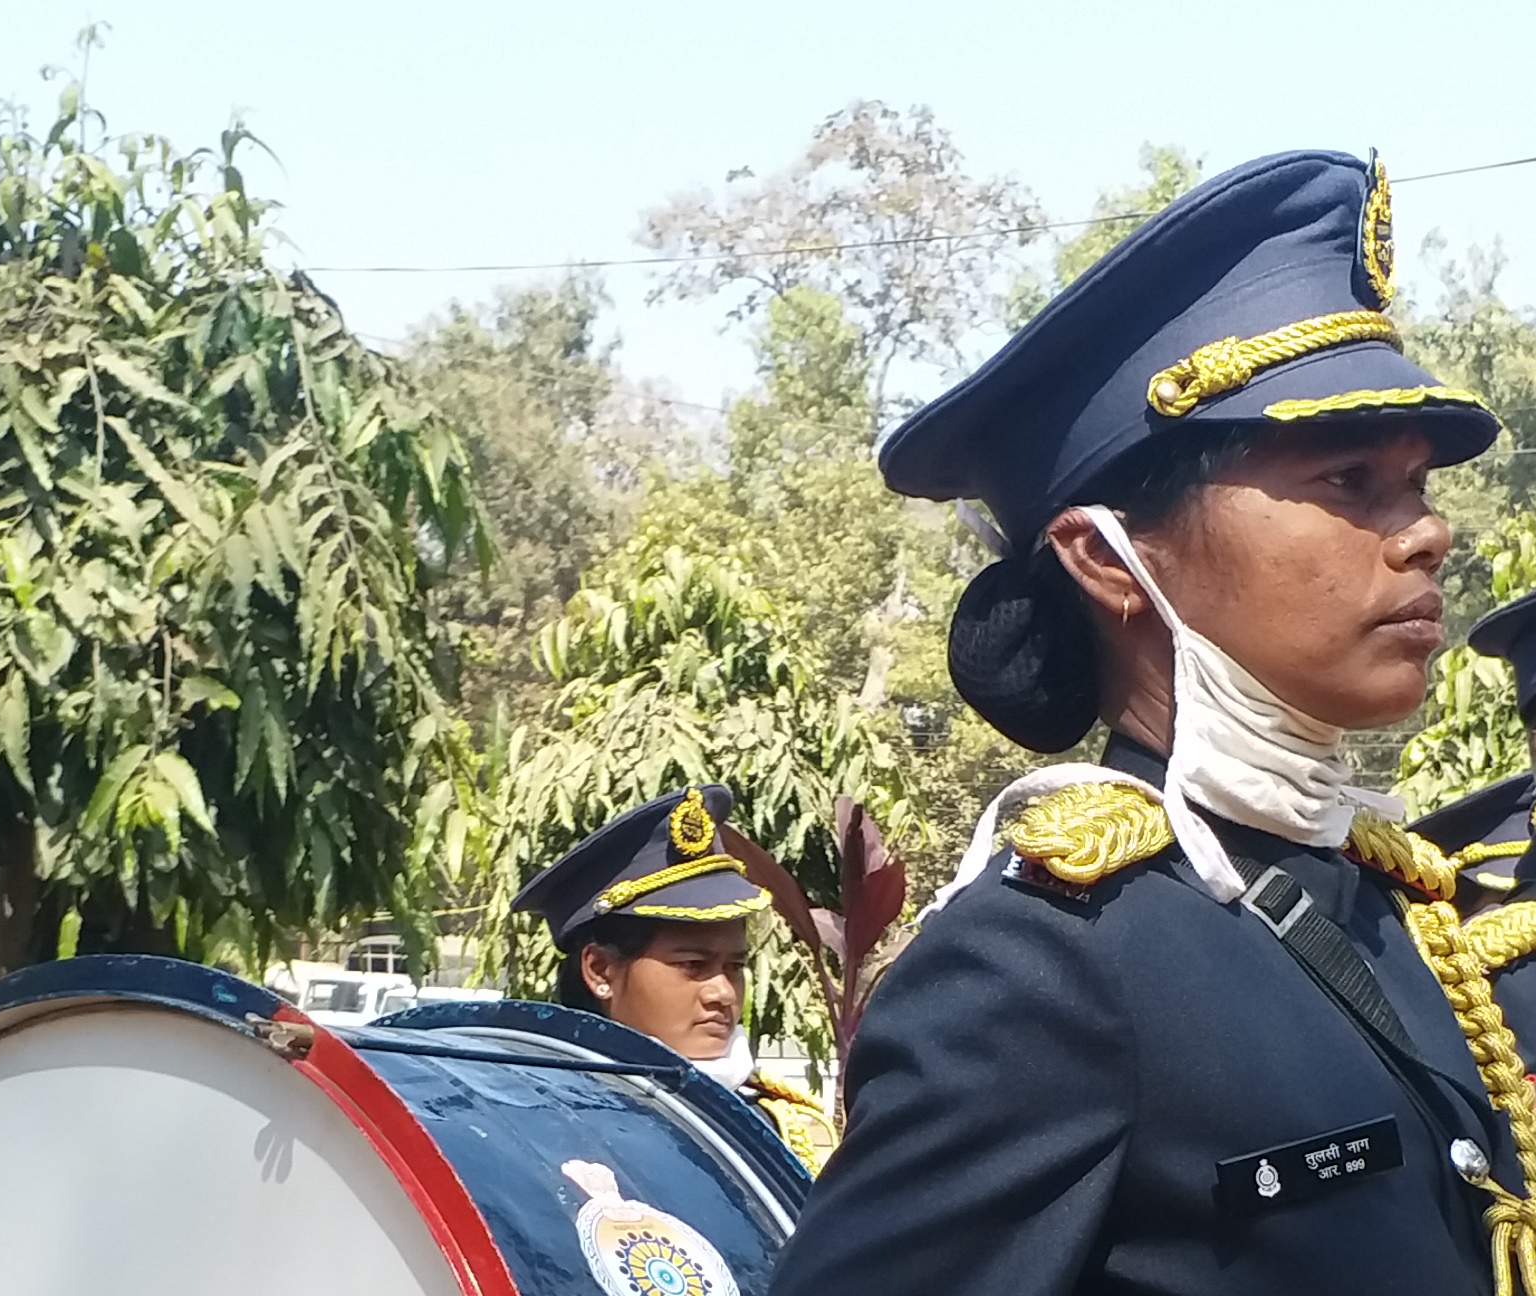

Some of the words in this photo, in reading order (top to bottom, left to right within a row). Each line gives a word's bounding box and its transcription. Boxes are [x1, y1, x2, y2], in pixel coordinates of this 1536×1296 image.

[1304, 1142, 1341, 1170] तुलसी
[1345, 1137, 1370, 1154] नाग
[1345, 1157, 1365, 1173] 899
